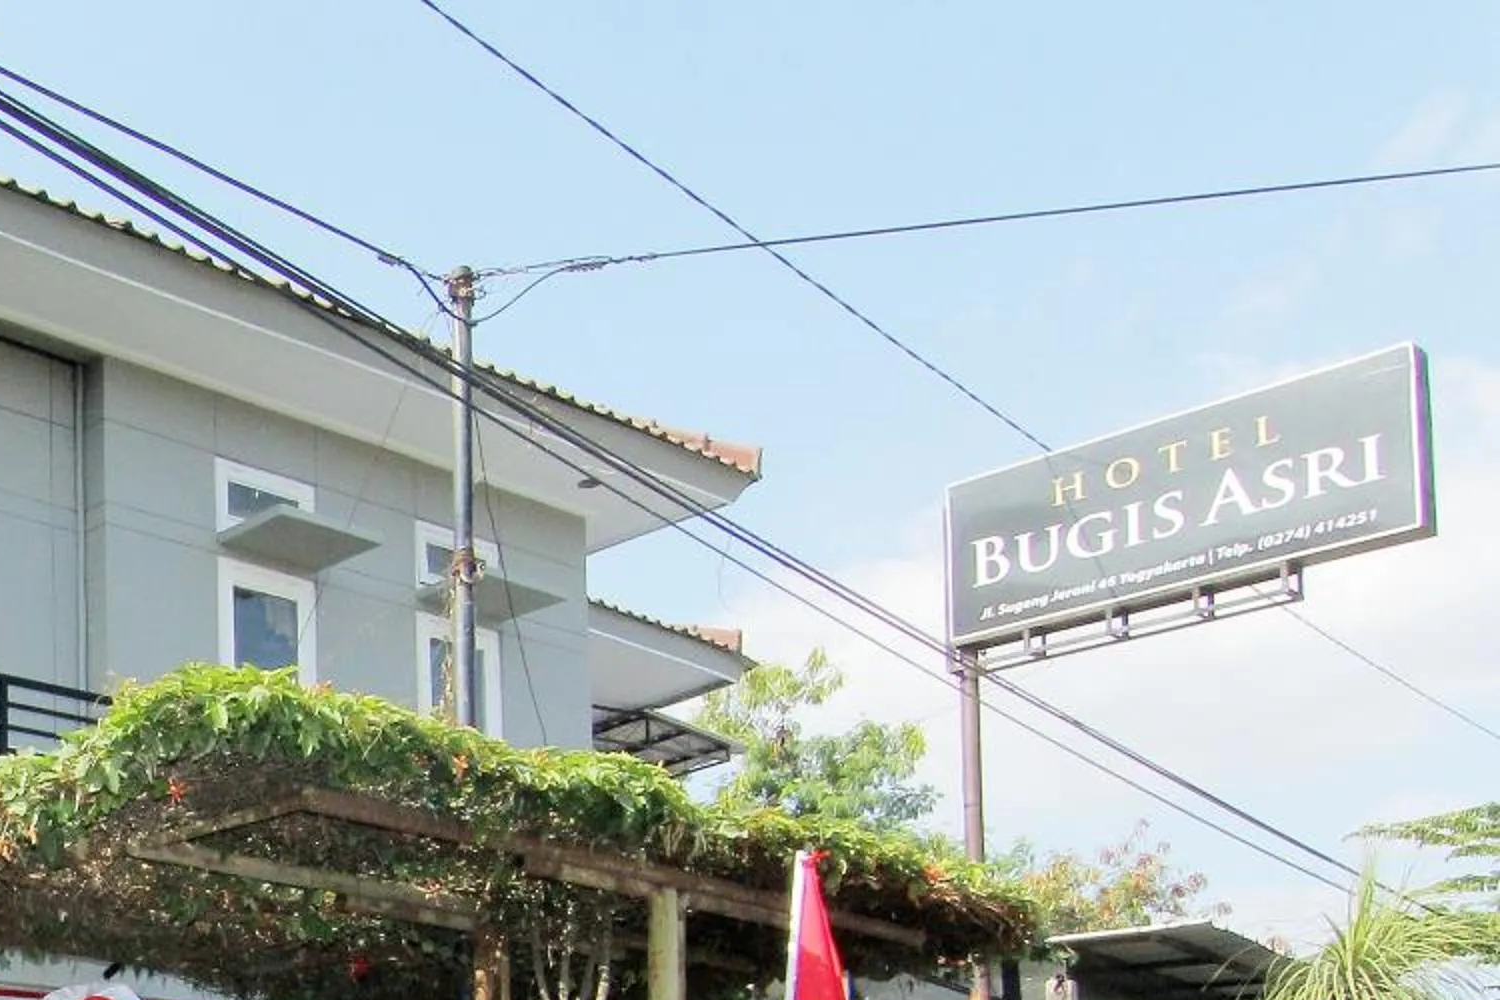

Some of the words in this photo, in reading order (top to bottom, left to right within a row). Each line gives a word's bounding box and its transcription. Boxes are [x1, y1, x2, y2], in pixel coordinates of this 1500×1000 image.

[970, 489, 1185, 588] BUGIS
[1198, 433, 1387, 527] ASRI
[1051, 415, 1282, 507] HOTEL
[979, 606, 996, 621] Jl.
[998, 593, 1049, 616] Sugeng
[1120, 552, 1206, 588] Yogyakarta
[1257, 525, 1311, 551] (0274)
[1314, 508, 1378, 535] 414251
